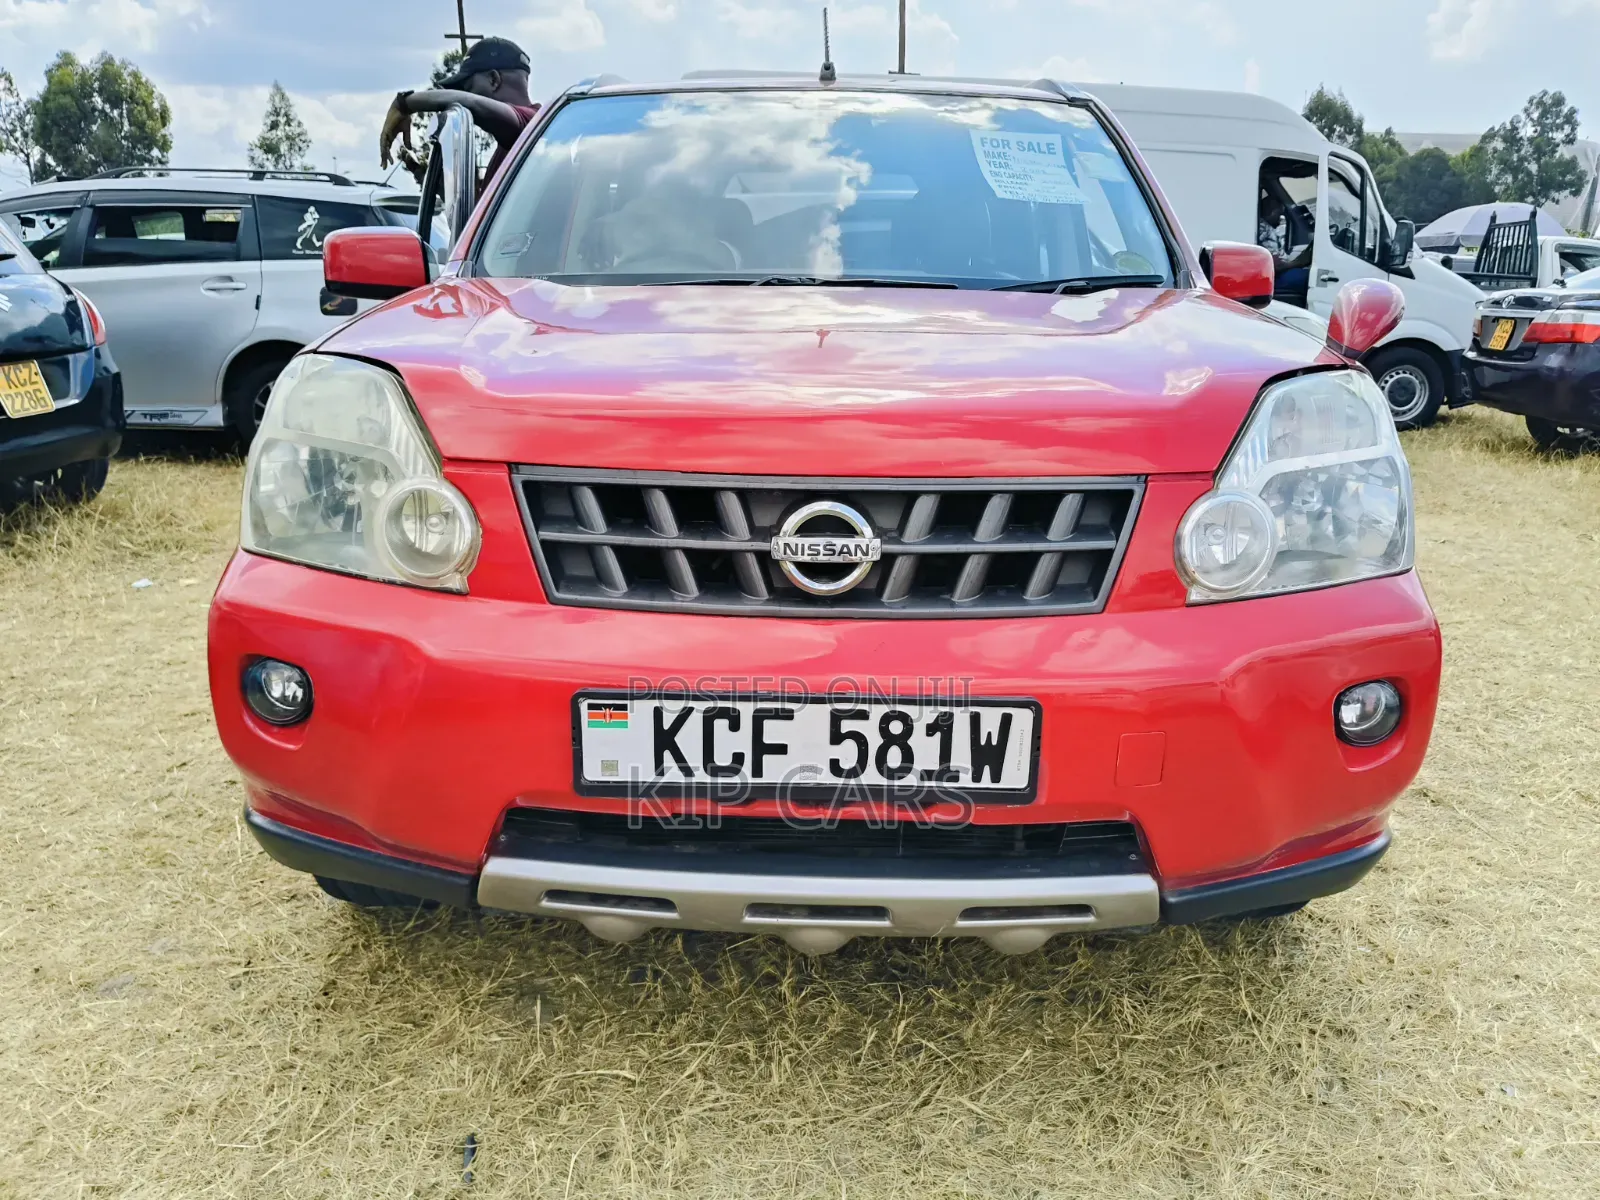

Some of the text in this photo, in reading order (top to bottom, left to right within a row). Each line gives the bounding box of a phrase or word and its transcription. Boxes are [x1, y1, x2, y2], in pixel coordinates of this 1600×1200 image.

[980, 137, 1057, 155] FOR SALE
[983, 150, 1012, 161] MAKE:
[985, 160, 1013, 171] YEAR:
[2, 364, 39, 390] KCZ
[4, 389, 49, 413] 228G
[783, 542, 870, 557] NISSAN
[653, 705, 1013, 784] KCF 581W
